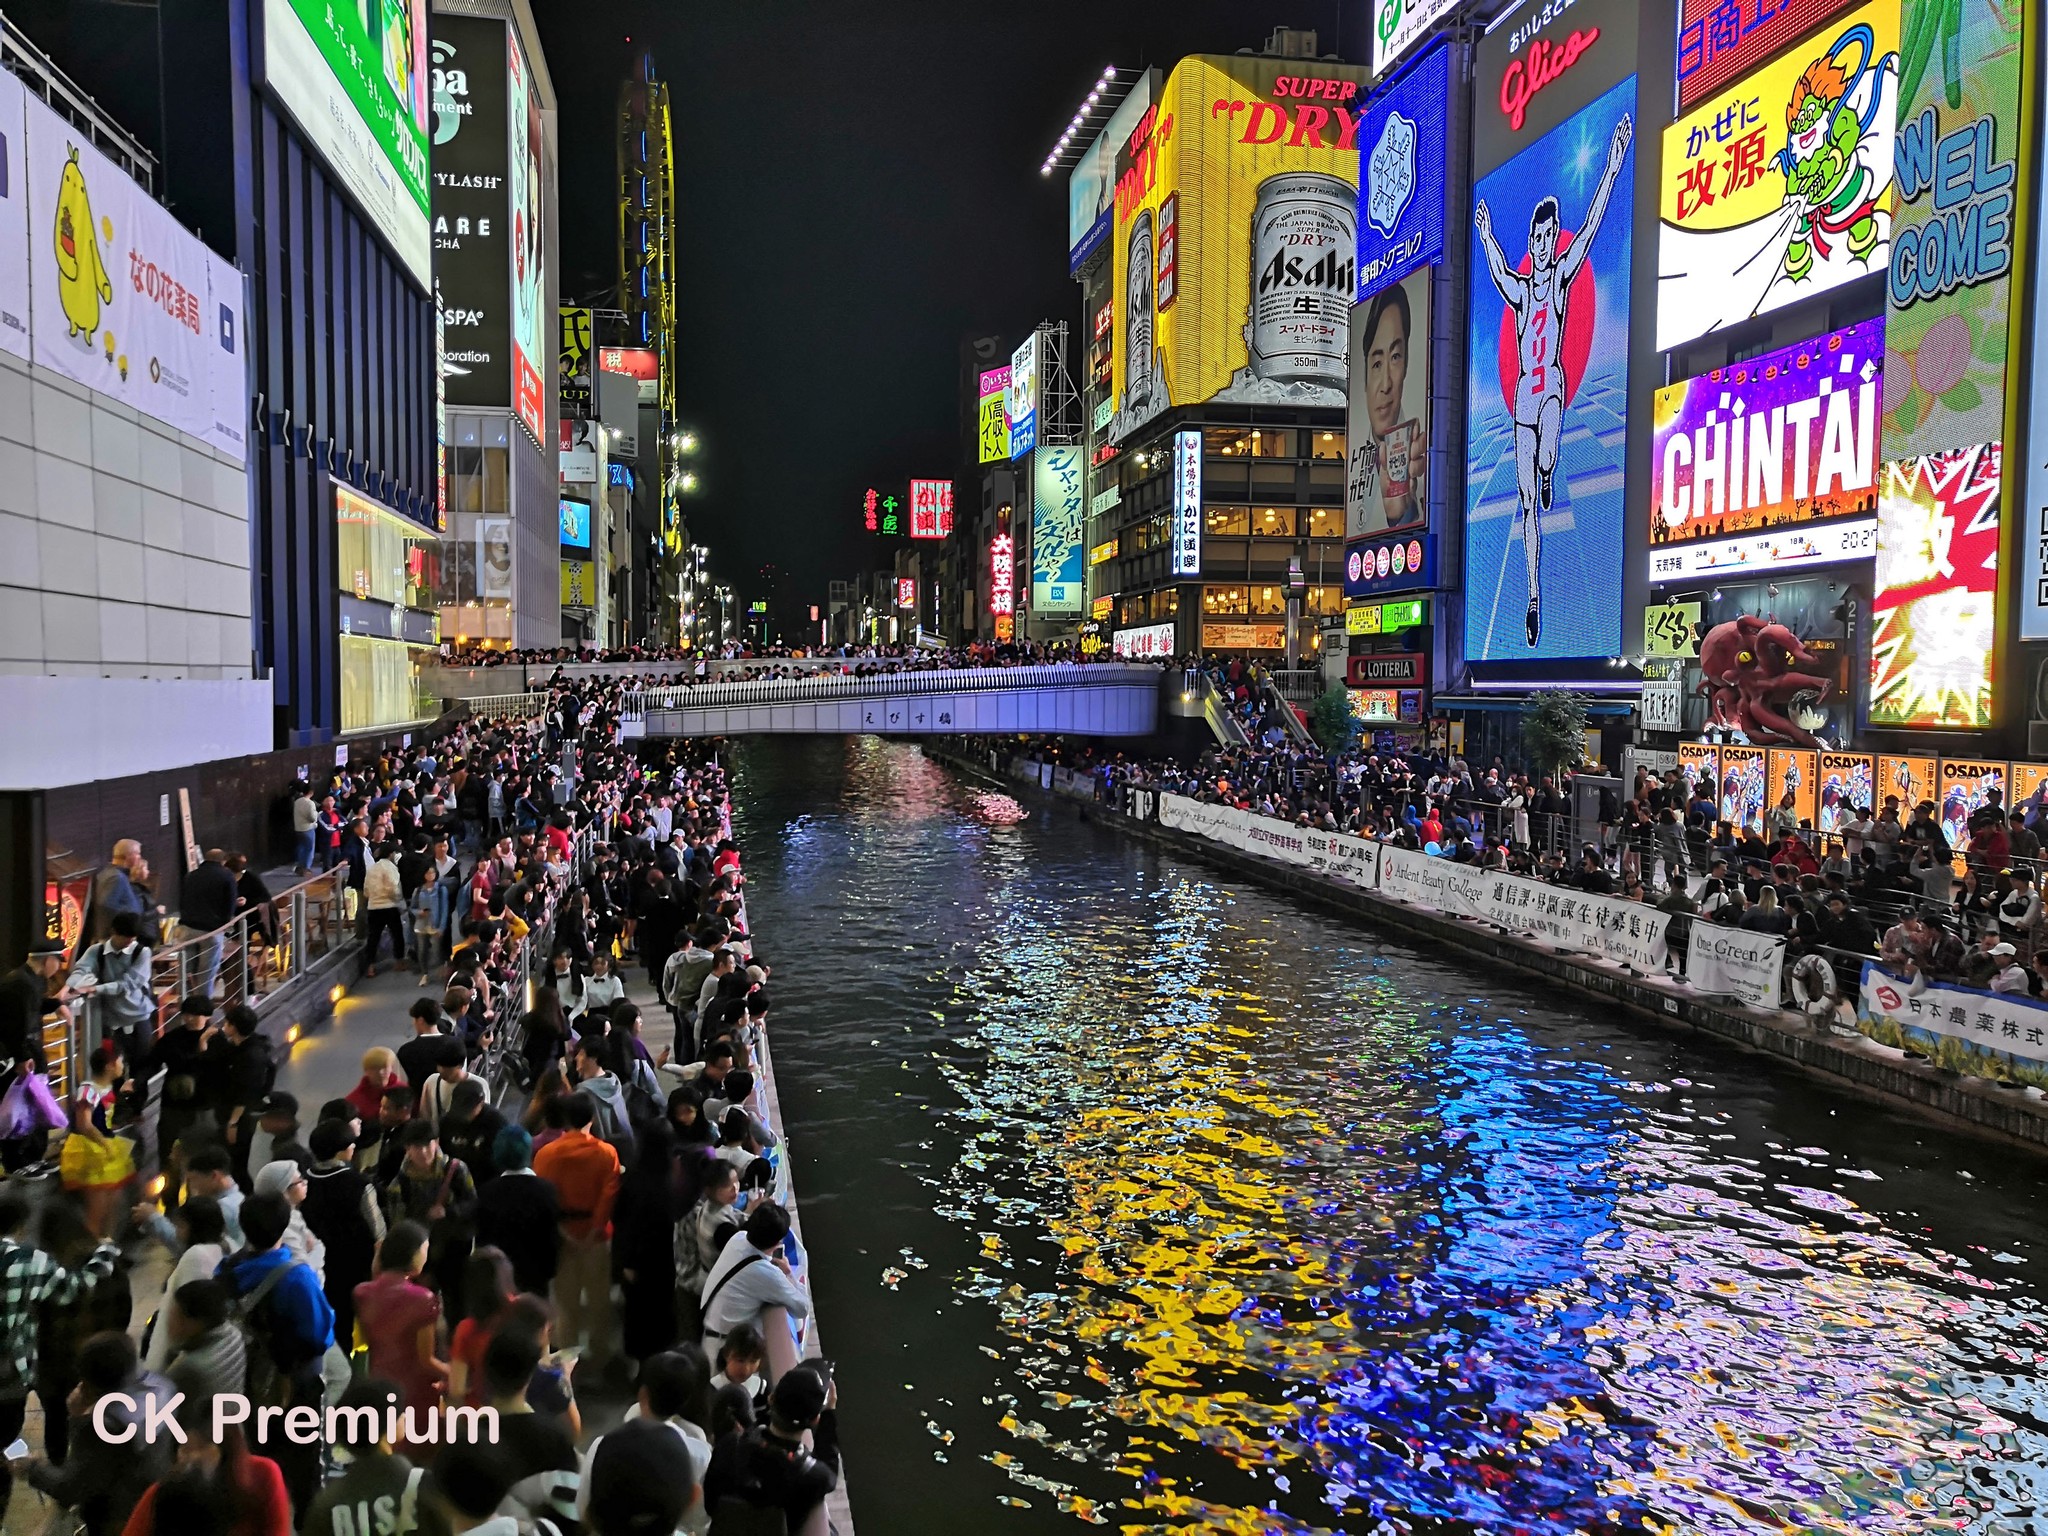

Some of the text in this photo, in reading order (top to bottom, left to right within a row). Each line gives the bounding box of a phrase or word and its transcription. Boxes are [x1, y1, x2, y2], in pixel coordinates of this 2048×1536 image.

[1273, 76, 1356, 100] SUPER
[1500, 27, 1600, 131] Glico
[1129, 104, 1157, 157] SUPER
[1686, 95, 1760, 159] かぜに
[1677, 123, 1768, 221] 改源
[1896, 109, 2013, 211] WEL
[1316, 223, 1340, 232] BRAND
[1360, 231, 1423, 287] 雪印メグミルク
[1891, 194, 2009, 302] COME
[1259, 246, 1355, 297] Asahi
[129, 248, 200, 335] なの花薬局
[1293, 296, 1320, 315] 生
[1279, 323, 1336, 337] スーパードライ
[1531, 302, 1550, 395] グリコ
[1294, 356, 1318, 368] 350ml
[982, 402, 993, 459] バイト
[993, 400, 1004, 458] 高収入
[1661, 378, 1877, 528] CHINTAI
[1185, 454, 1197, 499] 本場の味
[883, 496, 898, 530] 千房
[1790, 537, 1805, 546] 18時
[990, 533, 1012, 613] 大阪王将
[1655, 557, 1682, 572] 天気予報
[1052, 588, 1064, 598] BX
[1368, 661, 1411, 677] LOTTERIA
[865, 711, 952, 726] えびす橋
[1681, 746, 1717, 758] OSAKA
[1724, 749, 1764, 761] OSAKA
[1823, 755, 1871, 770] OSAKA
[1944, 763, 2003, 779] OSAKA
[1395, 864, 1419, 883] Ardent
[1422, 870, 1445, 895] Beauty
[1448, 877, 1482, 904] College
[1714, 939, 1759, 963] Green
